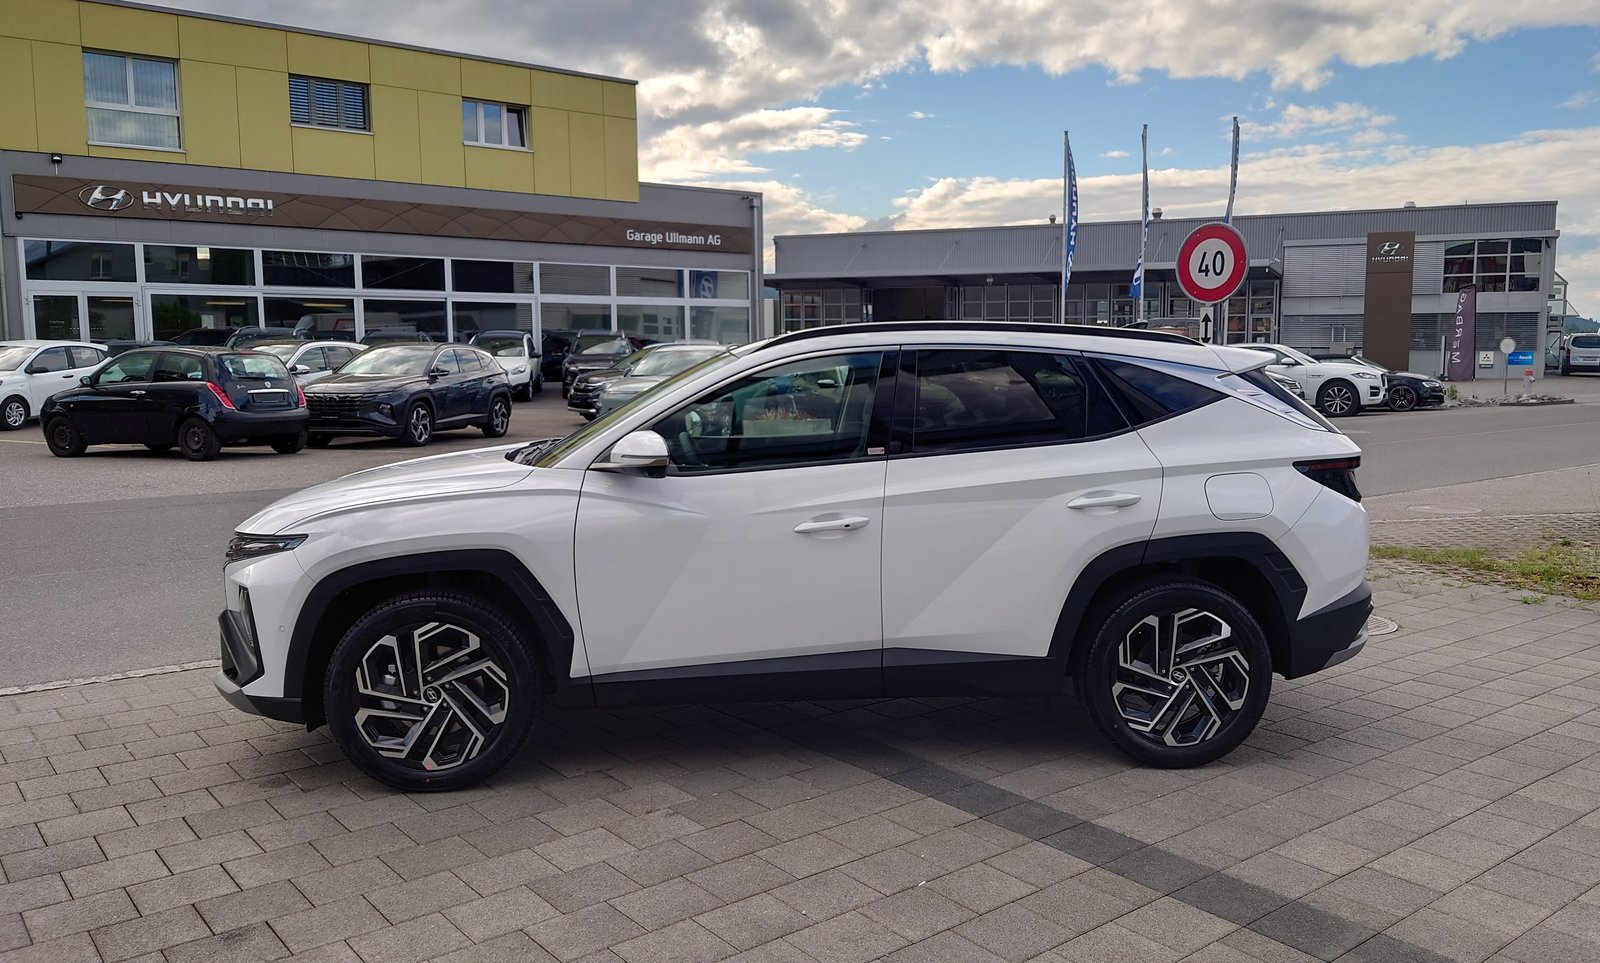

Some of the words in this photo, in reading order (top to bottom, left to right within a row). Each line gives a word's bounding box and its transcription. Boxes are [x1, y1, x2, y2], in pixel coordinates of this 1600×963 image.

[142, 191, 273, 217] HYUNDAI
[626, 230, 663, 245] Garage
[666, 232, 705, 245] Ullmann
[707, 234, 721, 246] AG
[1198, 250, 1225, 277] 40
[1371, 255, 1409, 263] HYUNDAI
